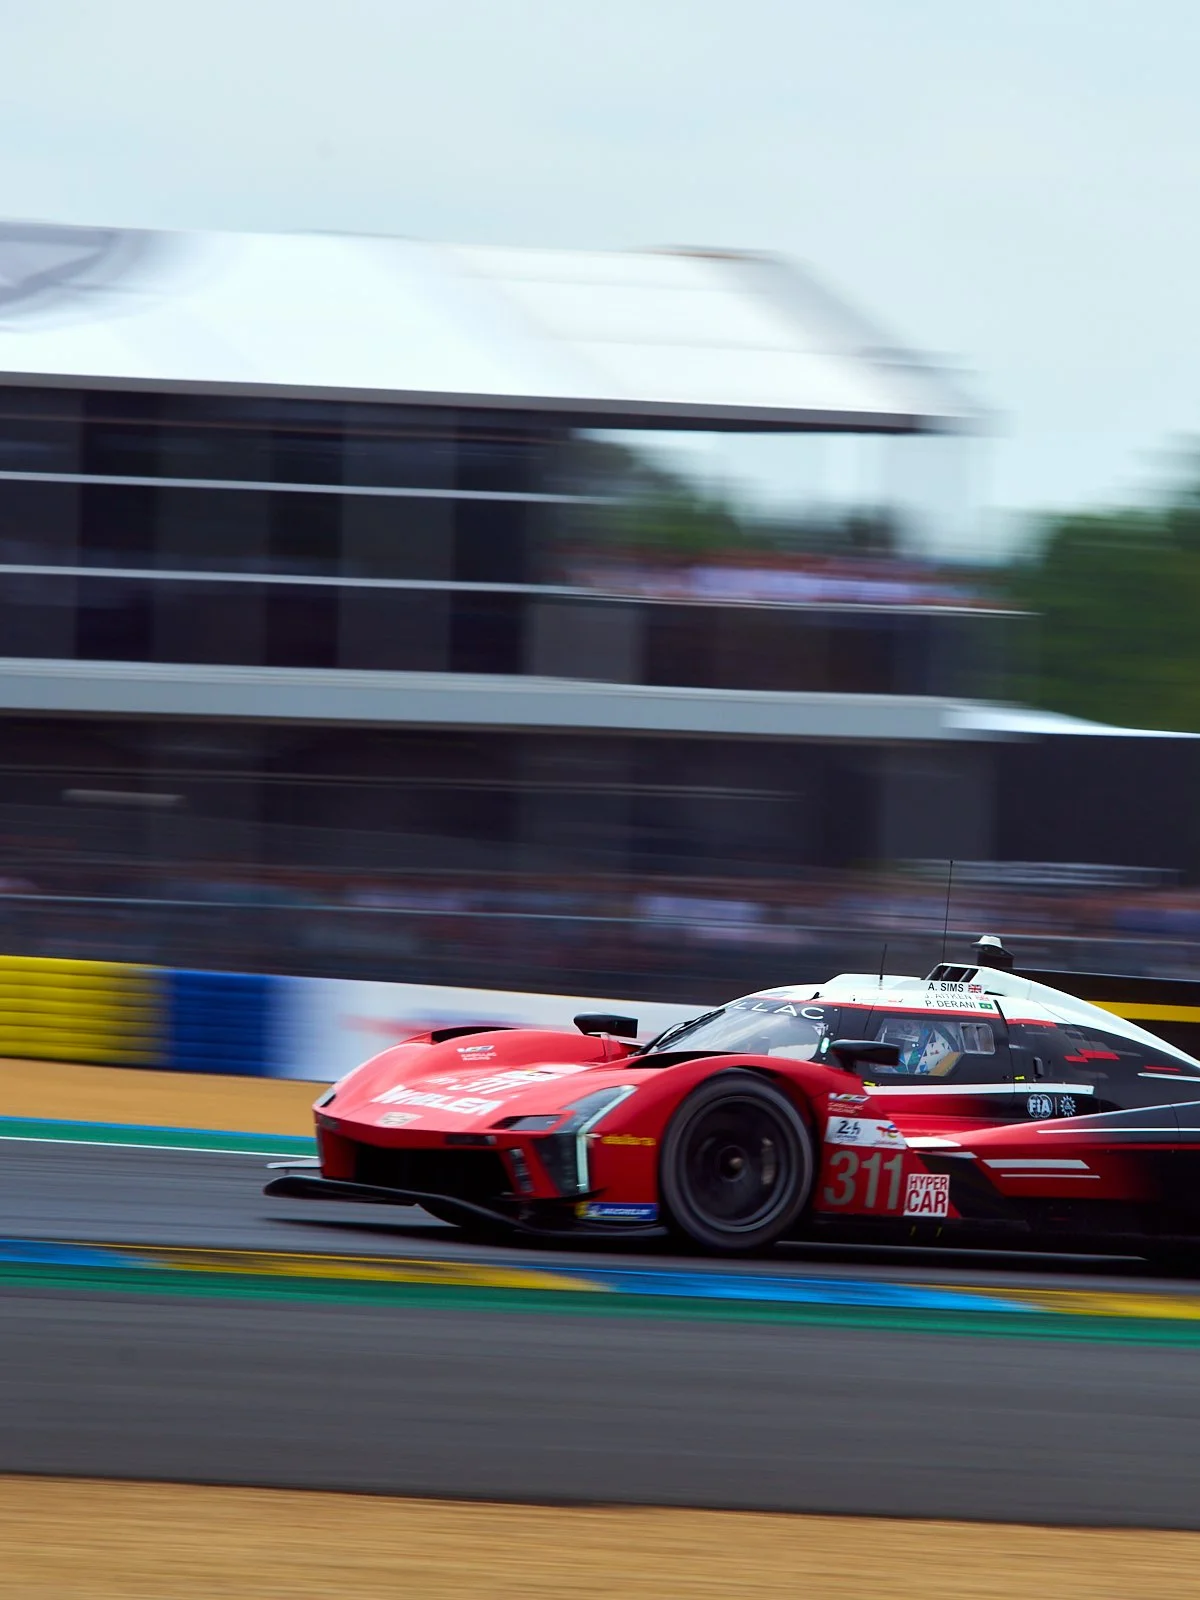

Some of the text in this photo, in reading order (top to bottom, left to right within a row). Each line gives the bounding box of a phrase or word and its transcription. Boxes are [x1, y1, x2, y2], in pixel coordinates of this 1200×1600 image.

[940, 982, 964, 992] SIMS
[937, 1000, 976, 1009] DERANI
[1029, 1098, 1051, 1113] FIA
[824, 1150, 904, 1210] 311
[909, 1175, 948, 1191] HYPER
[906, 1190, 947, 1213] CAR
